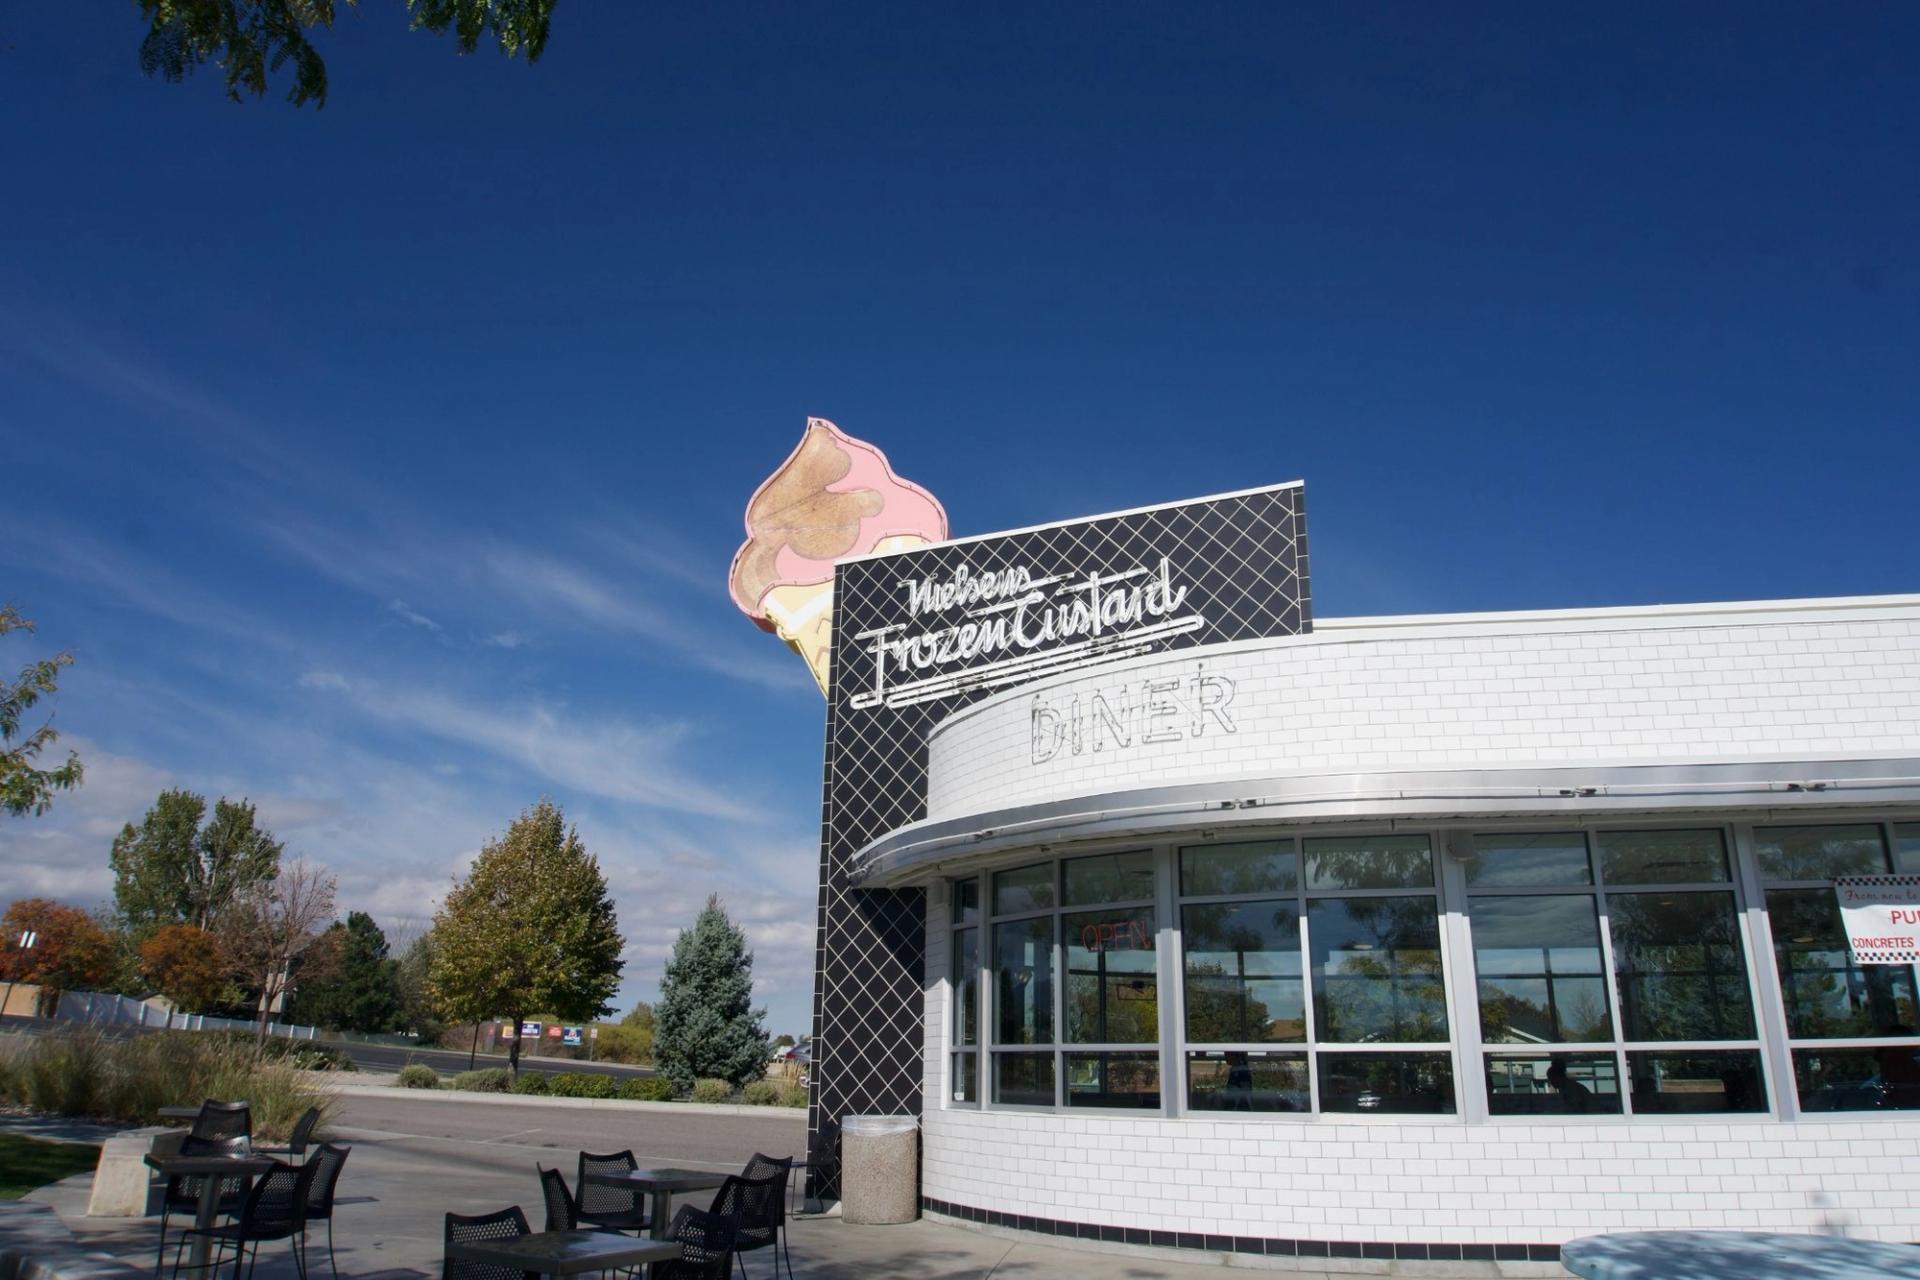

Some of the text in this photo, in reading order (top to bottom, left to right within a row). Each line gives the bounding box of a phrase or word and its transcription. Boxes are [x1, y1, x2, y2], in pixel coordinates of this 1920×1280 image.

[855, 557, 1187, 706] Frozen Custard
[1031, 664, 1238, 765] DINER
[1082, 919, 1152, 951] OPEN
[1852, 937, 1914, 948] CONCRETES
